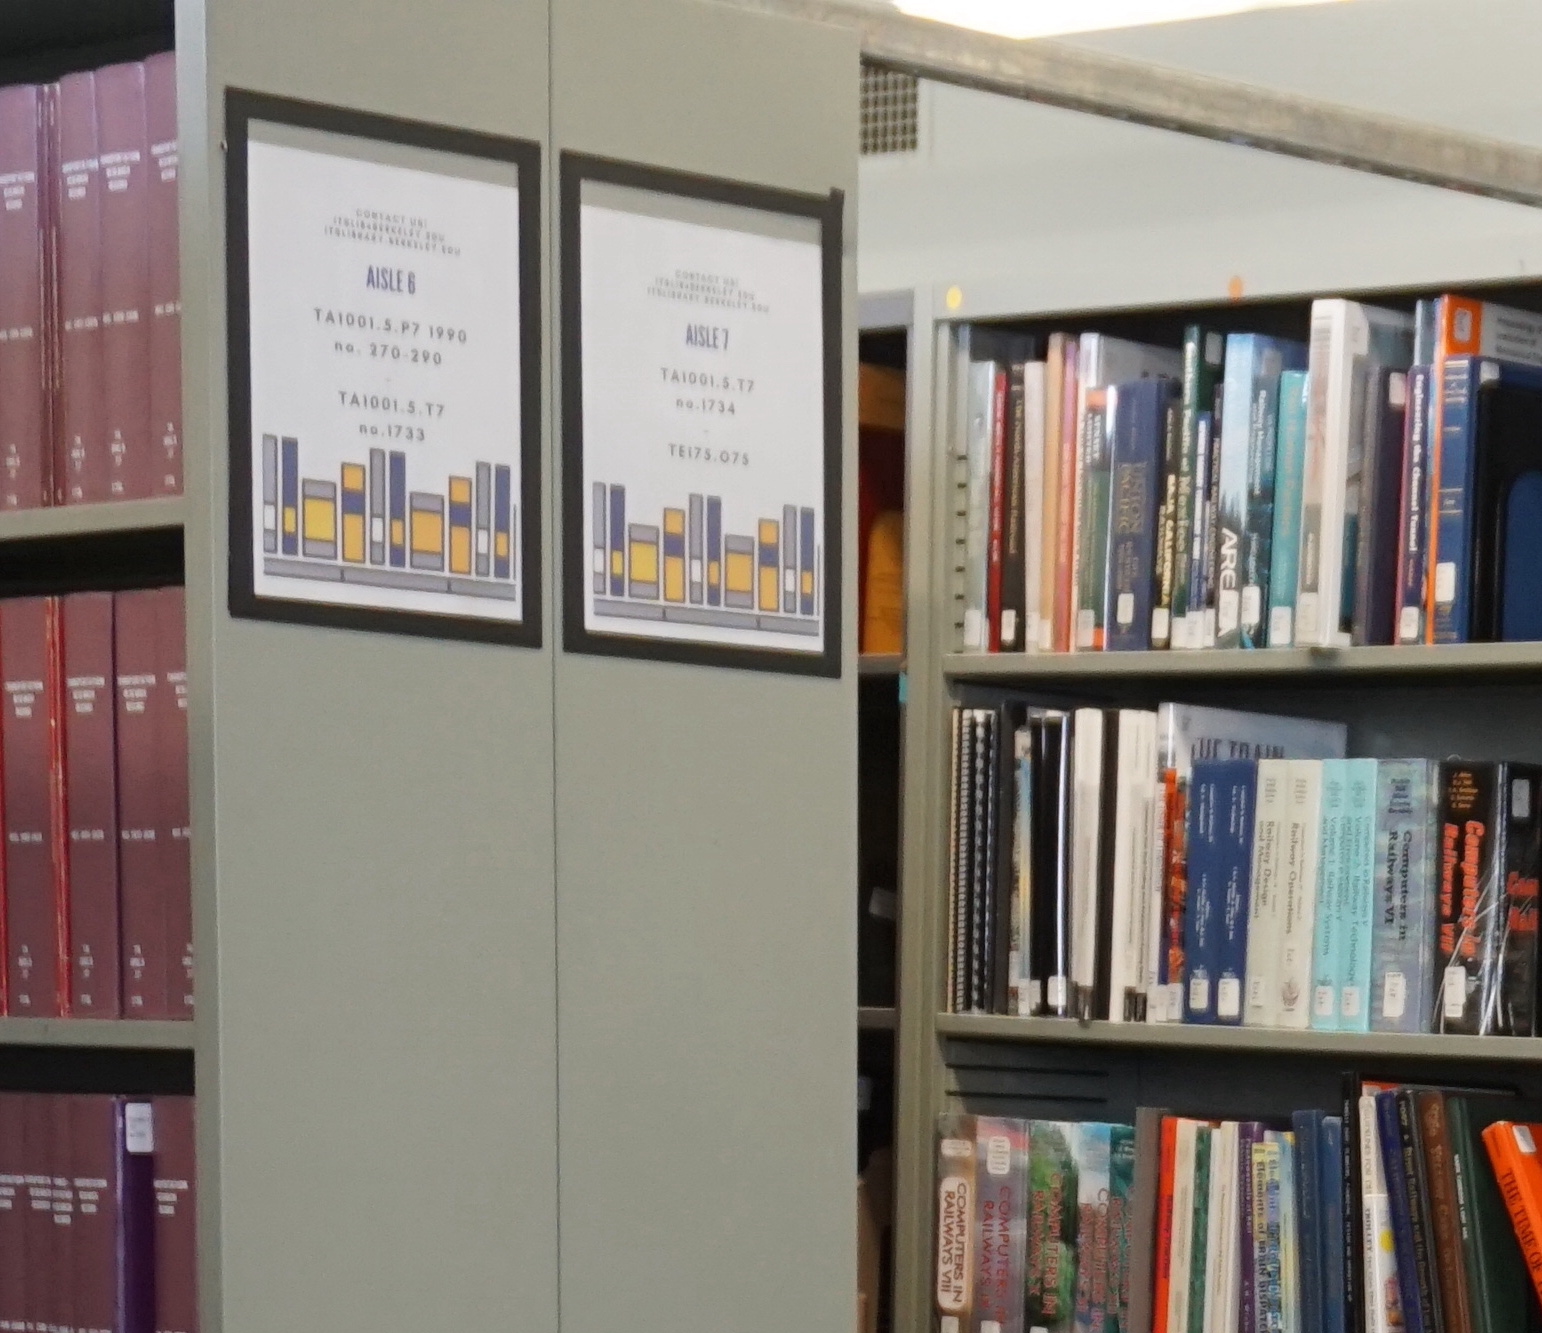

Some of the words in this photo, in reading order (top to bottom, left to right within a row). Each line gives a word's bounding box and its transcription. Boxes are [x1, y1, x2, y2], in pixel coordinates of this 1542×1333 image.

[366, 264, 404, 293] AISLE
[408, 270, 416, 295] 6
[429, 324, 468, 344] 1990
[686, 322, 719, 350] AISLE
[722, 328, 729, 351] 7
[1412, 374, 1424, 442] Engineering
[1411, 444, 1422, 463] the
[1410, 466, 1421, 512] Channel
[1409, 514, 1420, 552] Tunnel
[1384, 830, 1399, 903] Railways
[1399, 830, 1413, 921] Computers
[1440, 822, 1459, 917] Railways
[1460, 820, 1486, 929] Computers
[1384, 906, 1395, 925] VI
[1398, 924, 1409, 942] in
[1255, 1161, 1267, 1218] Elements
[1501, 1168, 1522, 1206] THE
[1514, 1206, 1539, 1250] TIME
[941, 1191, 956, 1266] RAILWAYS
[953, 1182, 967, 1281] COMPUTERS
[980, 1200, 995, 1287] RAILWAYS
[995, 1186, 1011, 1299] COMPUTERS
[941, 1270, 953, 1293] VIII
[952, 1285, 963, 1303] IN
